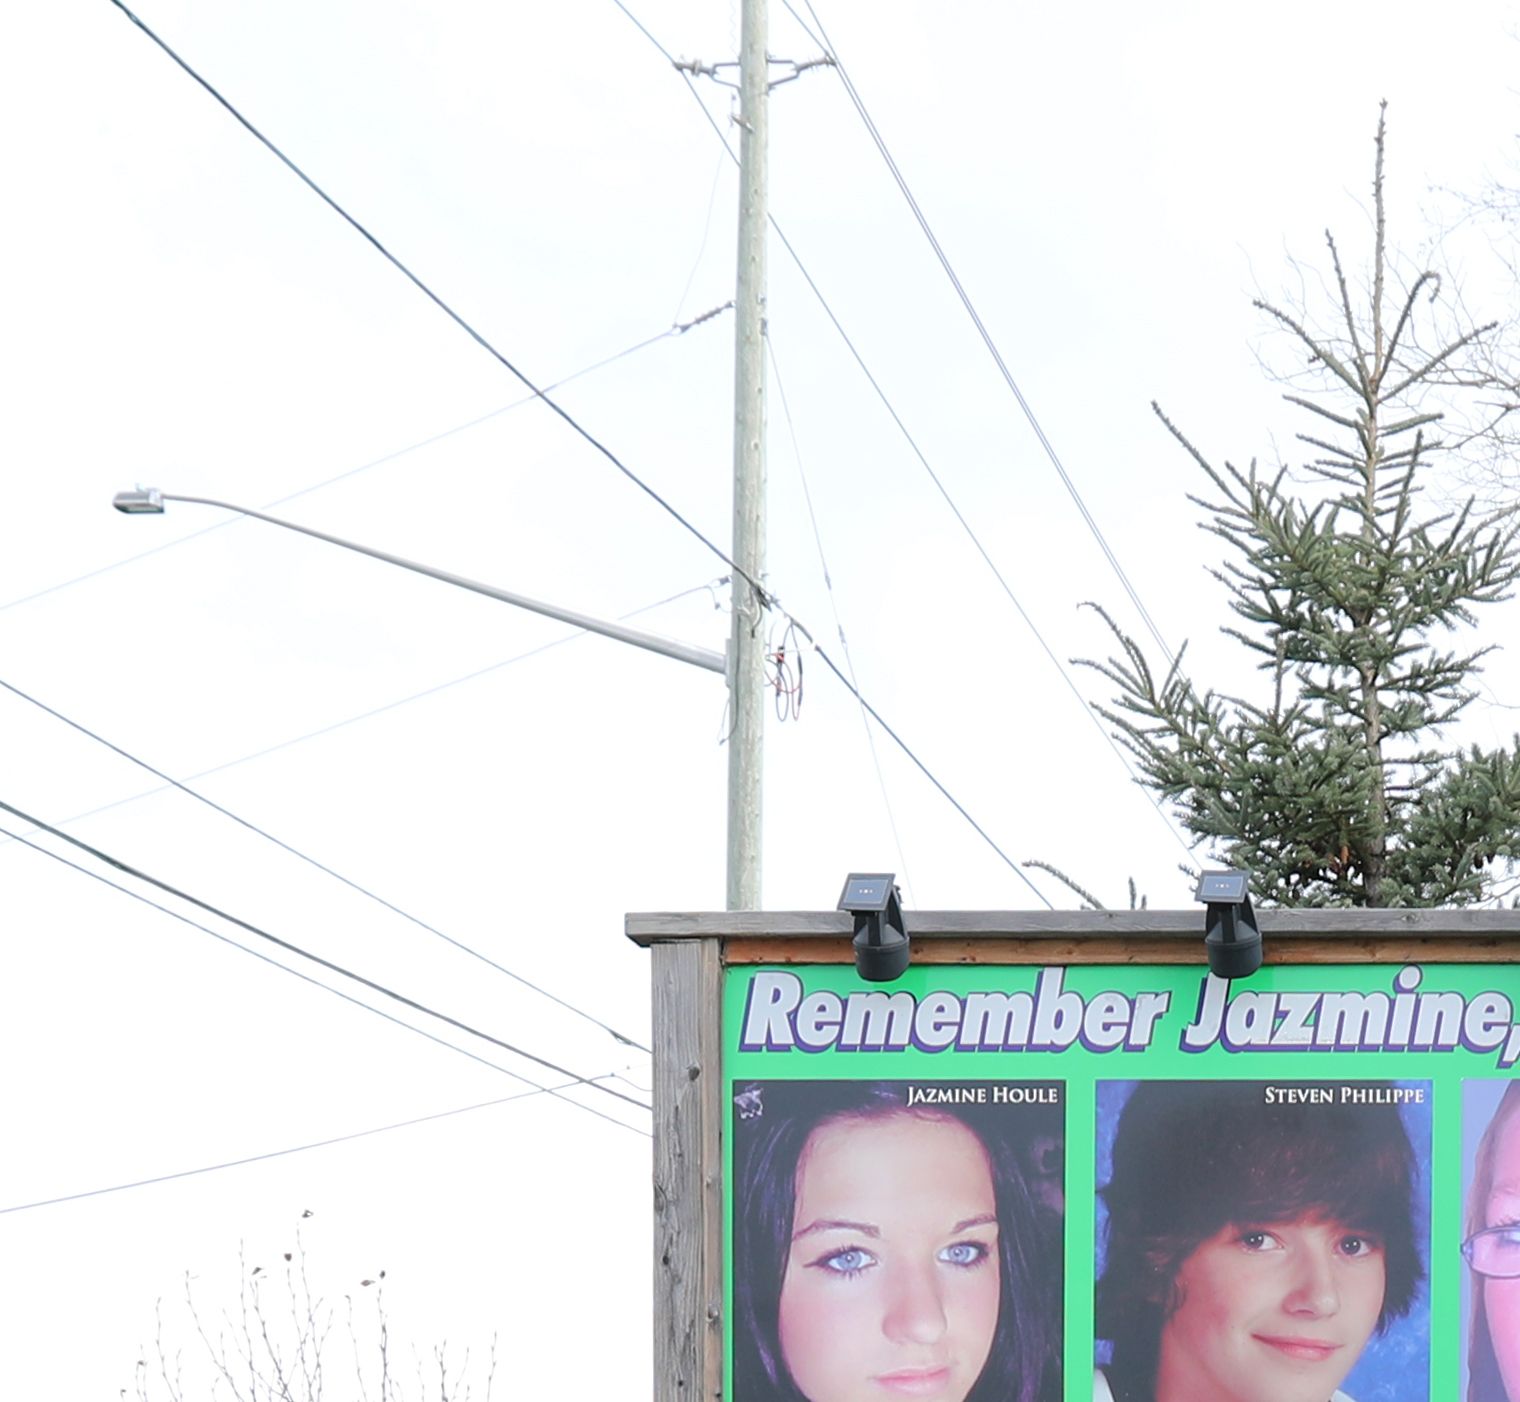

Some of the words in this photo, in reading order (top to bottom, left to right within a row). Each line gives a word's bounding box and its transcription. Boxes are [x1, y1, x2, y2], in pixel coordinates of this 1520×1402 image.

[740, 966, 1171, 1051] Remember
[907, 1087, 986, 1106] JAZMINE
[993, 1087, 1058, 1103] HOULE
[1265, 1087, 1333, 1103] STEVEN
[1341, 1087, 1424, 1103] PHILIPPE
